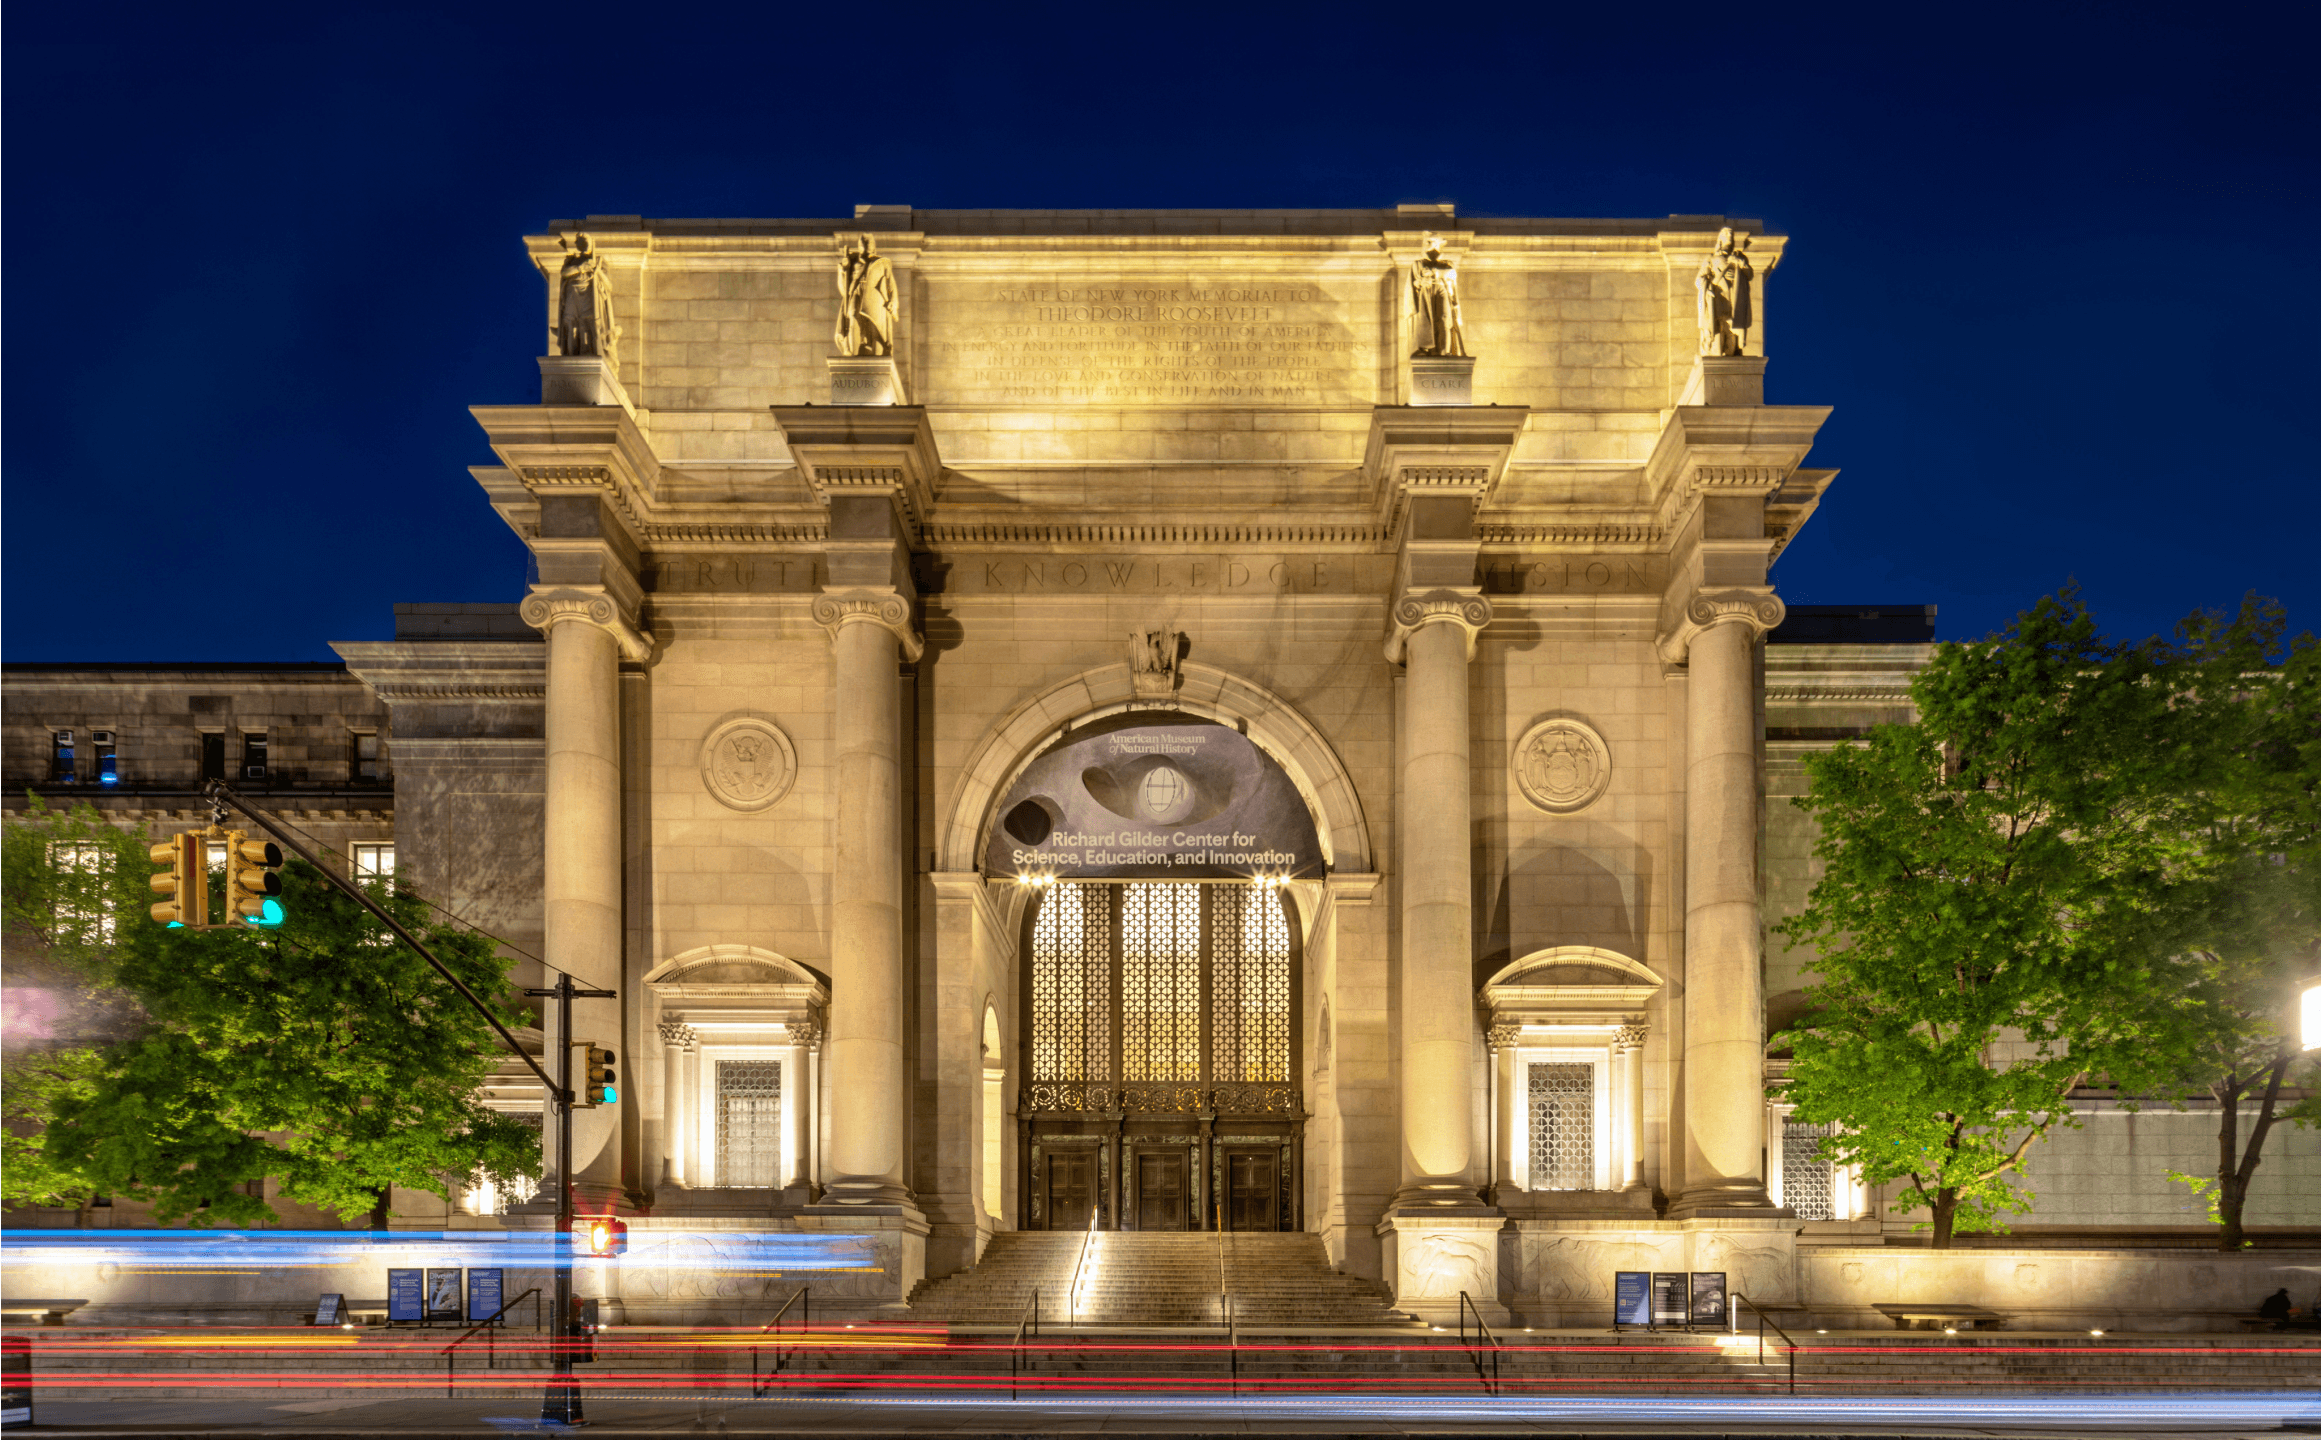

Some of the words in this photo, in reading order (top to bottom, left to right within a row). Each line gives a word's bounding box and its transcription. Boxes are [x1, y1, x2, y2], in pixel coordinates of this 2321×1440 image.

[997, 288, 1049, 303] STATE
[1056, 288, 1080, 303] OF
[1086, 288, 1125, 303] NEW
[1133, 288, 1181, 303] YORK
[1189, 288, 1279, 303] MEMORIAL
[1287, 288, 1311, 303] TO
[1035, 305, 1147, 322] THEODORE
[1157, 305, 1274, 322] ROOSEVELT
[832, 379, 888, 389] AUDUBON
[1421, 379, 1466, 389] CLARK
[1712, 379, 1755, 389] LEWIS
[984, 560, 1330, 588] KNOWLEDGE
[1475, 561, 1648, 588] VISION
[1109, 734, 1158, 744] American
[1161, 734, 1206, 744] Museum
[1109, 744, 1120, 756] of
[1120, 744, 1159, 754] Natural
[1161, 744, 1198, 756] History
[1052, 831, 1115, 847] Richard
[1118, 831, 1169, 847] Gilder
[1172, 831, 1229, 847] Center
[1232, 831, 1256, 847] for
[1012, 849, 1082, 868] Science,
[1085, 849, 1172, 868] Education,
[1175, 849, 1206, 865] and
[1209, 849, 1295, 865] Innovation
